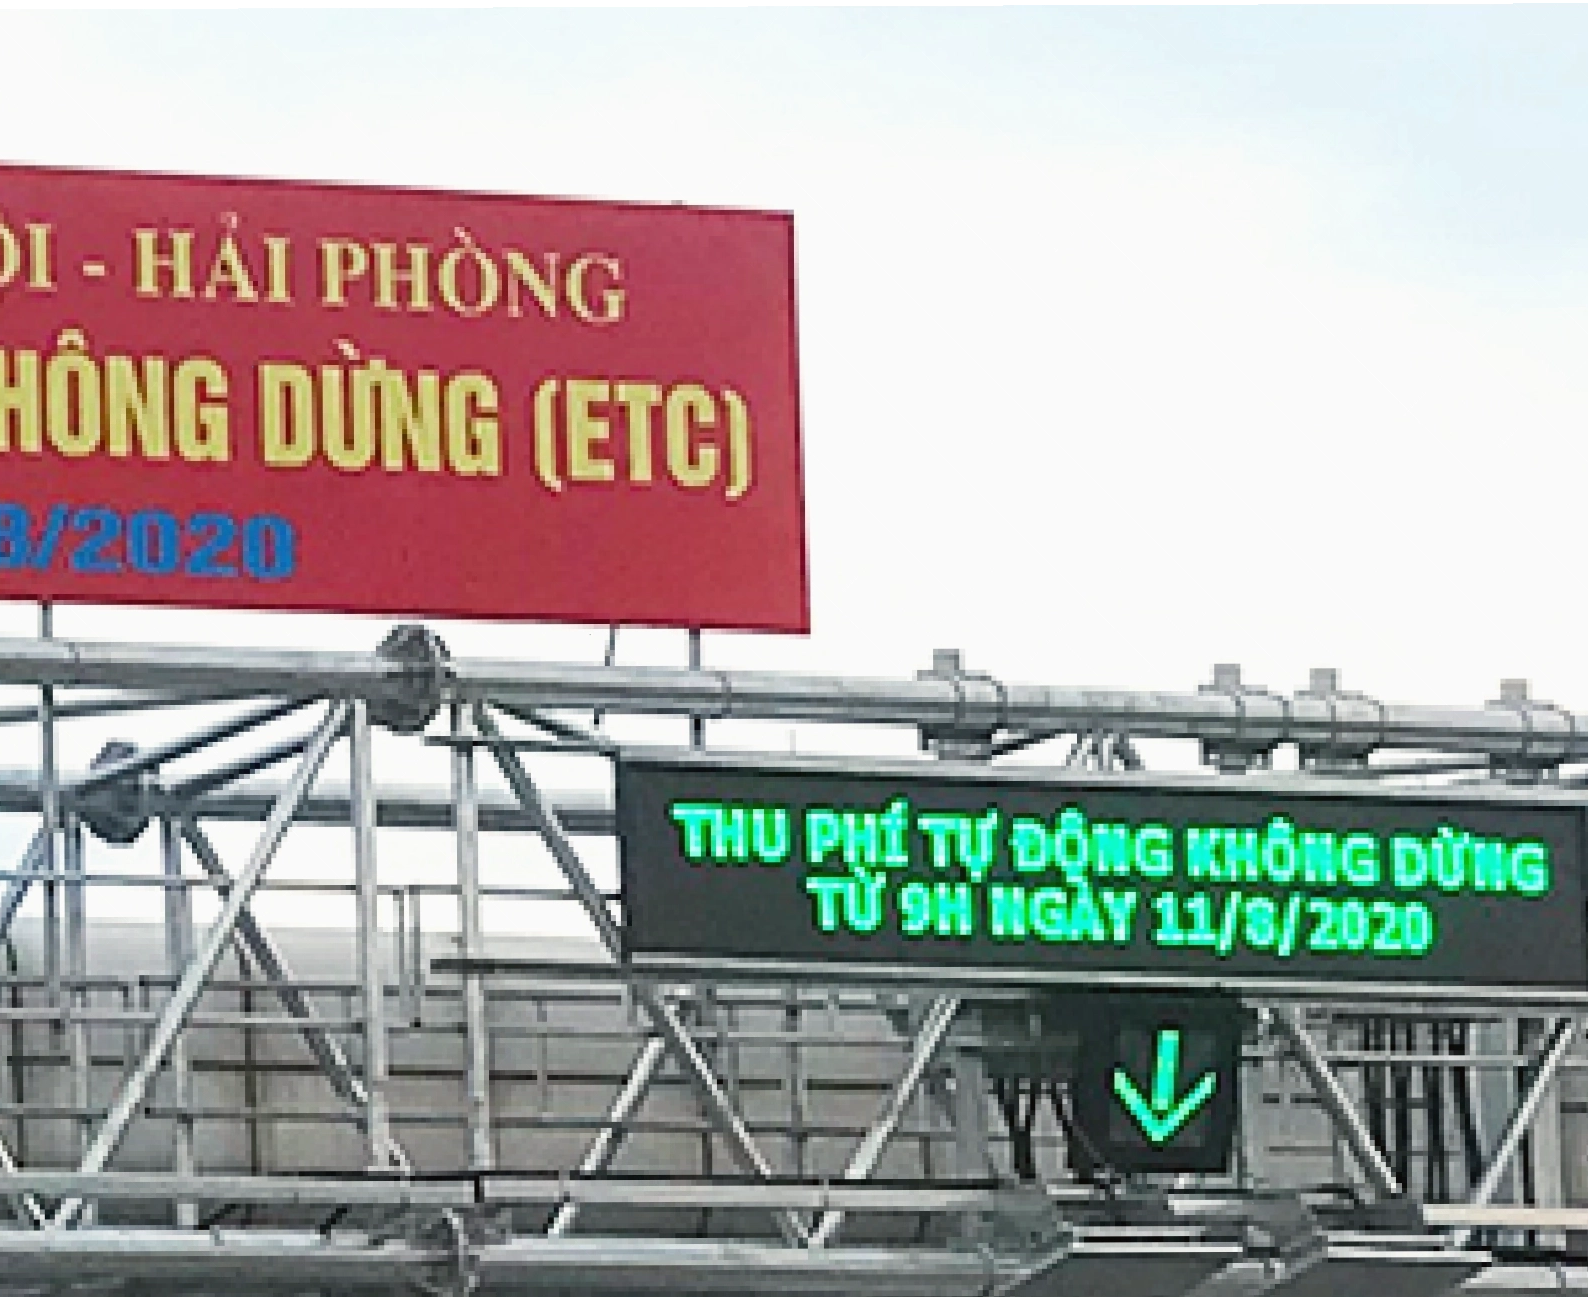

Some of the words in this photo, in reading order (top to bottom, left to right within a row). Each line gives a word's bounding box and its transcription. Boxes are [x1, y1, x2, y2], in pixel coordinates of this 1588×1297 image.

[132, 214, 292, 305] HẢI
[319, 228, 630, 324] PHÒNG
[258, 340, 503, 478] DỪNG
[531, 377, 753, 499] (ETC)
[670, 802, 788, 864] THU
[804, 797, 908, 869] PHÍ
[920, 808, 999, 881] TỰ
[1010, 806, 1171, 879] ĐỘNG
[1188, 816, 1381, 888] KHÔNG
[1390, 825, 1548, 896] DỪNG
[806, 870, 883, 935] TỪ
[901, 883, 973, 936] 9H
[993, 877, 1134, 946] NGÀY
